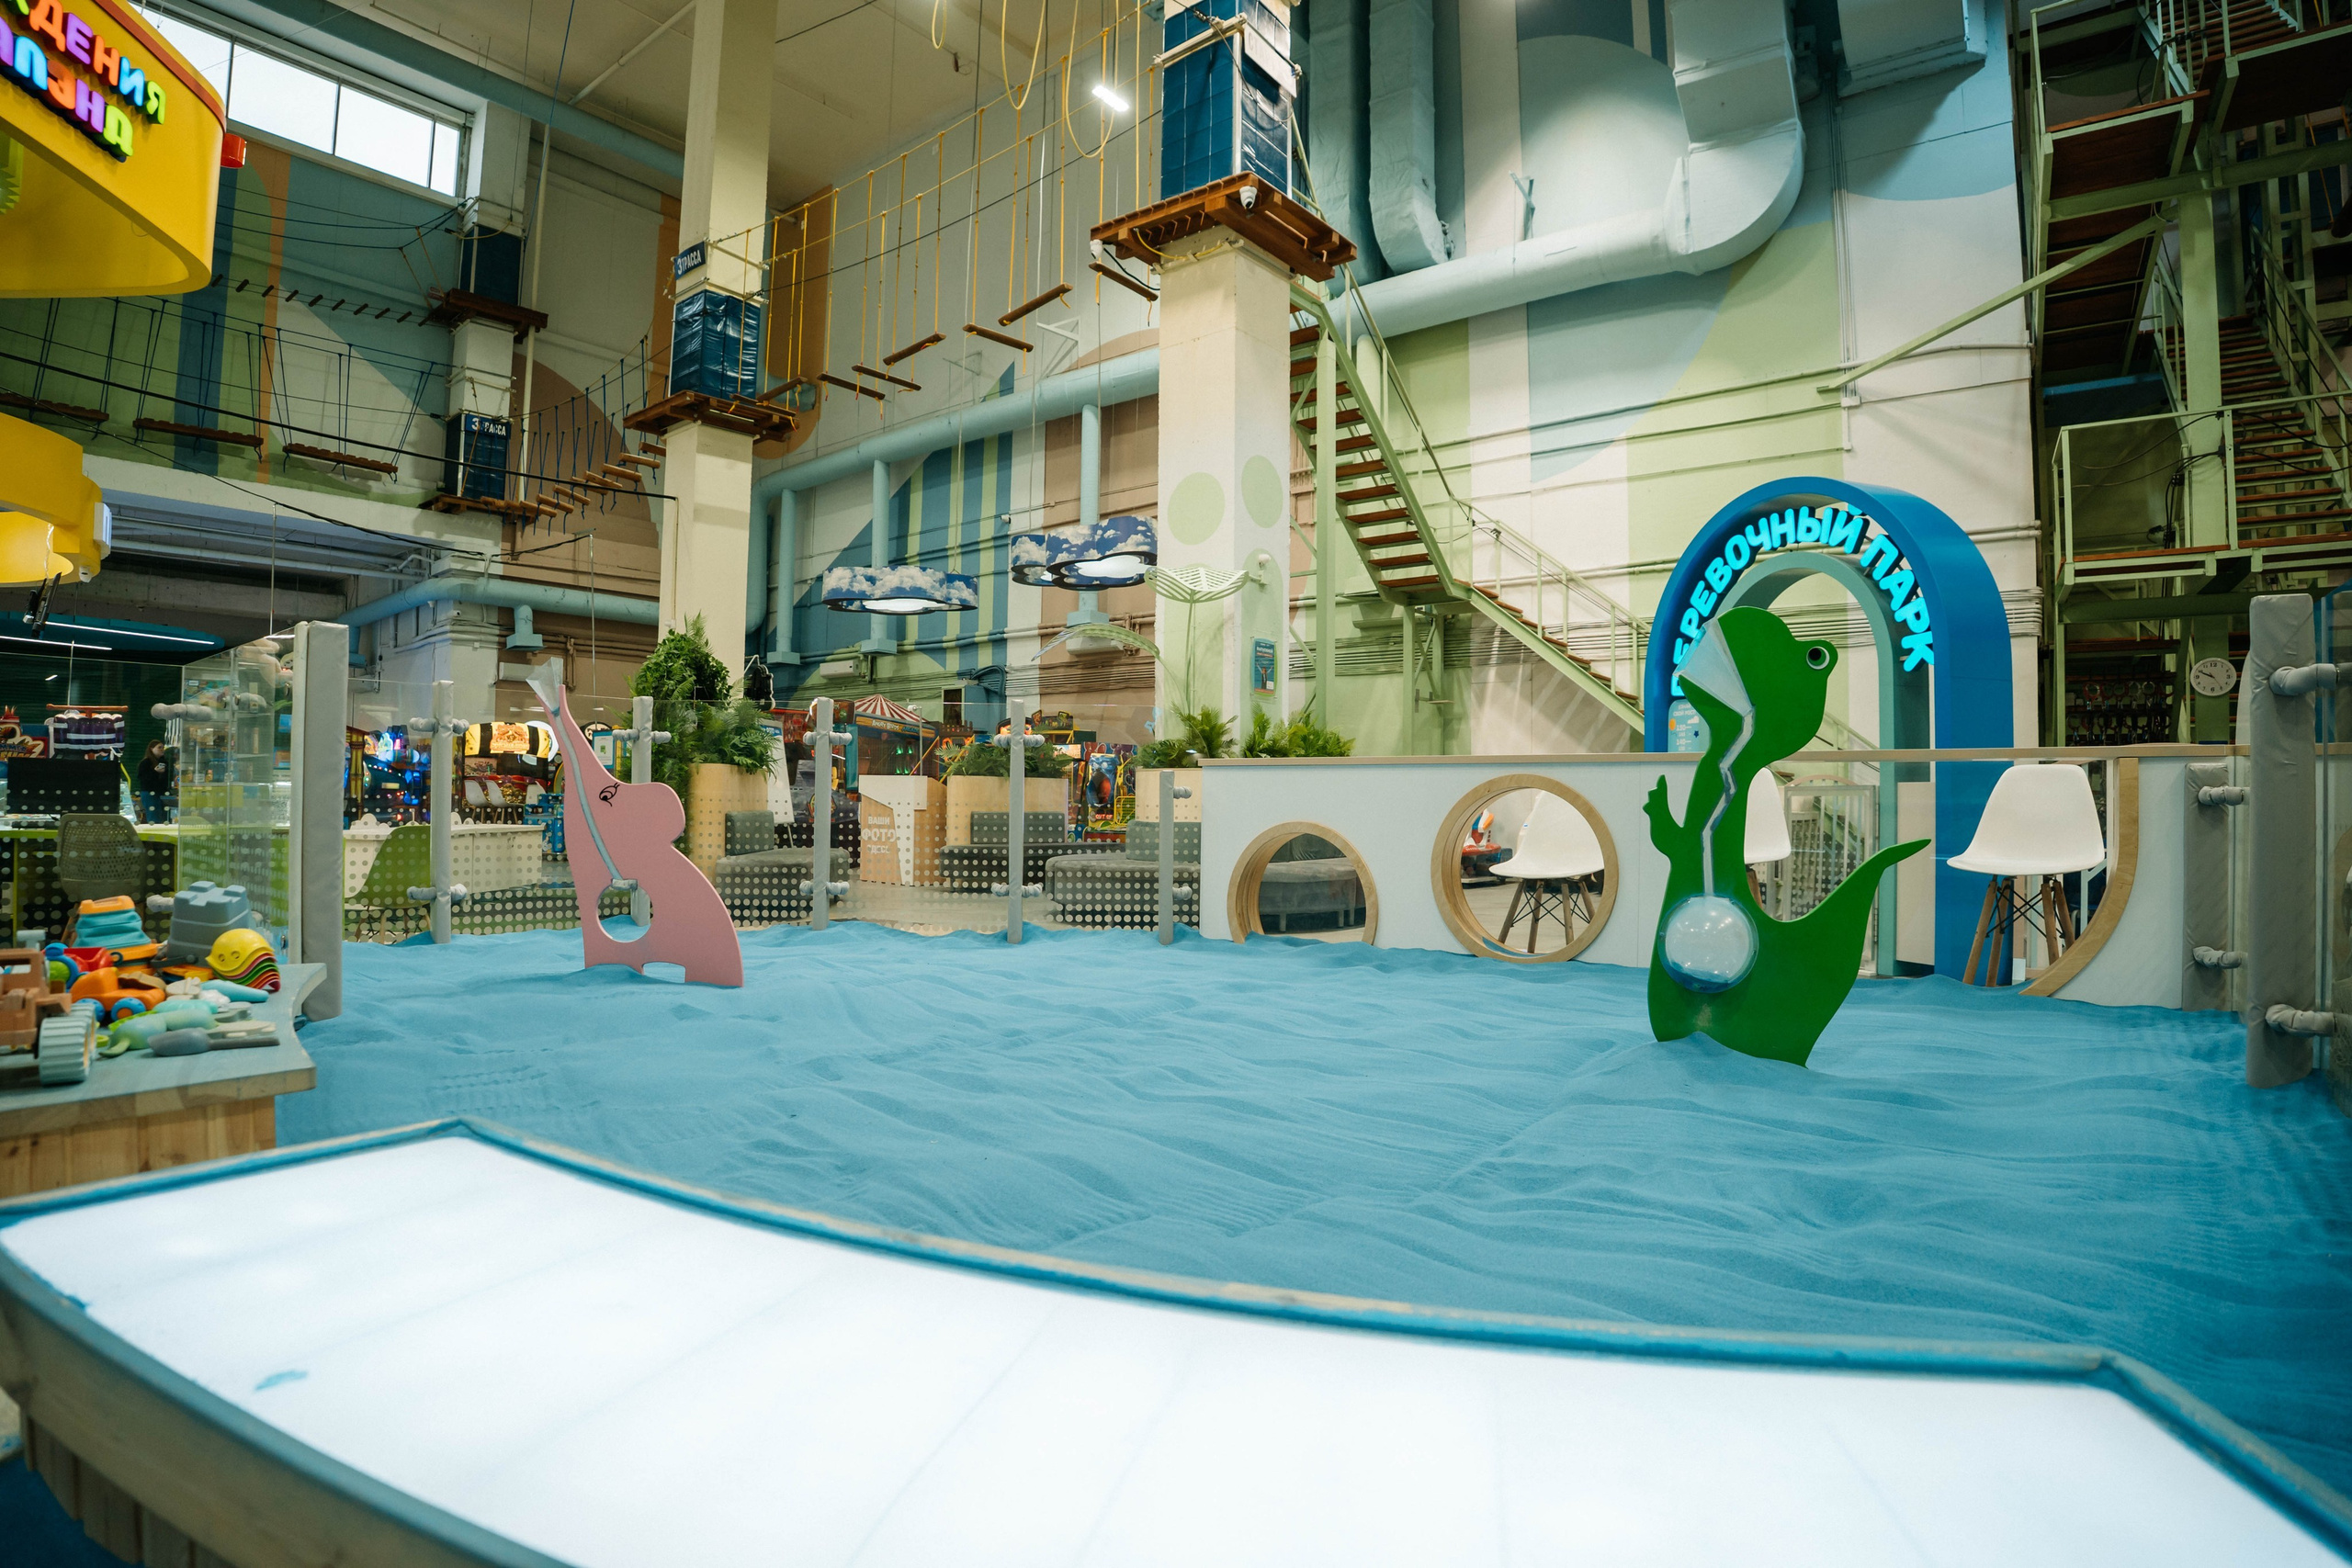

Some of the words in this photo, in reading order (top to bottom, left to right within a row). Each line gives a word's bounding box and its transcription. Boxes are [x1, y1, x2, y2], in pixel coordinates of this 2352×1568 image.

[16, 0, 166, 125] ДЕНИЯ
[471, 417, 480, 431] 3
[482, 422, 506, 436] РАССА
[1859, 534, 1935, 672] ПАРК
[867, 816, 890, 825] ВАШИ
[862, 828, 897, 842] ФОТО
